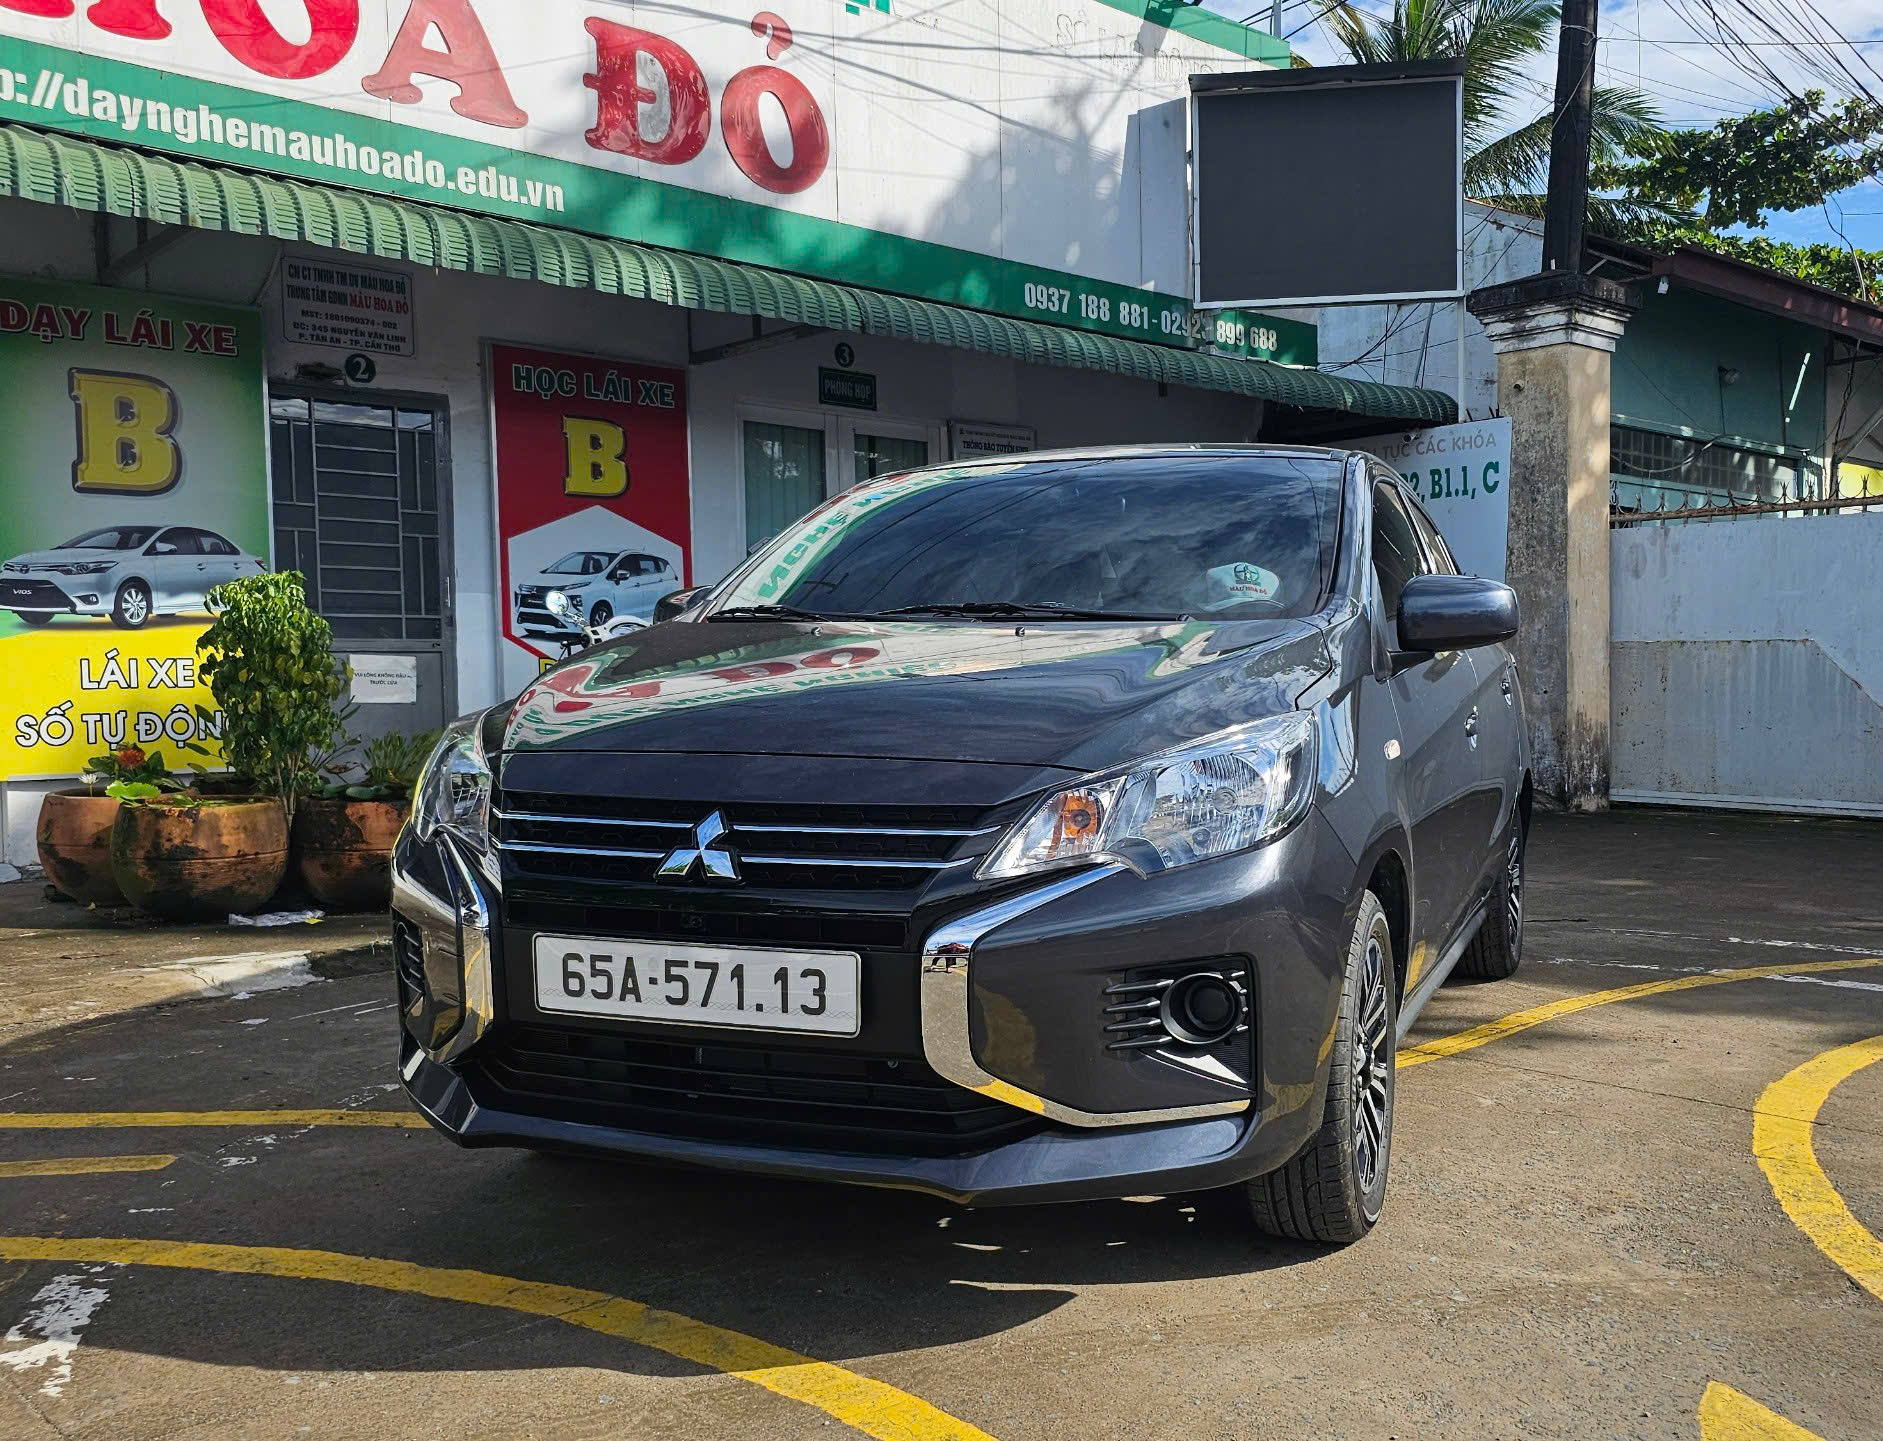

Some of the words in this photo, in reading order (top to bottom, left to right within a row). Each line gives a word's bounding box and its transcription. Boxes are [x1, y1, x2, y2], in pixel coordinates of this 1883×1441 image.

[582, 10, 830, 195] ĐỎ
[286, 284, 311, 301] TRUNG
[311, 285, 327, 303] TÂM
[349, 291, 372, 309] MÀU
[373, 297, 394, 313] HOA
[395, 296, 409, 314] ĐỎ
[302, 266, 312, 281] CT
[313, 267, 335, 284] TNHH
[335, 270, 348, 286] TM
[349, 273, 360, 288] DV
[379, 277, 395, 294] HOA
[0, 299, 90, 343] DẠY
[103, 308, 175, 350] LÁI
[183, 320, 238, 356] XE
[292, 321, 309, 331] ĐC:
[311, 323, 329, 333] 345
[330, 325, 366, 338] NGUYỄN
[367, 331, 385, 341] VĂN
[386, 334, 407, 344] LINH
[301, 310, 323, 320] MST:
[382, 321, 398, 330] 002
[1024, 282, 1071, 314] 0937
[1078, 293, 1111, 322] 188
[1216, 320, 1245, 346] 899
[1249, 326, 1278, 352] 688
[310, 333, 328, 343] TÂN
[329, 336, 342, 345] AN
[349, 339, 362, 348] TP.
[364, 339, 383, 350] CẦN
[839, 344, 851, 365] 3
[352, 357, 369, 379] 2
[512, 363, 577, 400] HỌC
[583, 370, 632, 404] LÁI
[638, 378, 675, 409] XE
[824, 378, 853, 397] PHÒNG
[854, 384, 871, 402] HỌP
[67, 366, 183, 496] B
[1415, 435, 1447, 455] CÁC
[1452, 429, 1497, 451] KHÓA
[562, 415, 629, 497] B
[1429, 465, 1477, 500] B1.1,
[1482, 461, 1500, 494] C
[80, 648, 139, 690] LÁI
[147, 658, 195, 689] XE
[15, 699, 74, 747] SỐ
[81, 710, 128, 751] TỰ
[134, 703, 230, 748] ĐỘN
[562, 952, 827, 1016] 65A-571.13
